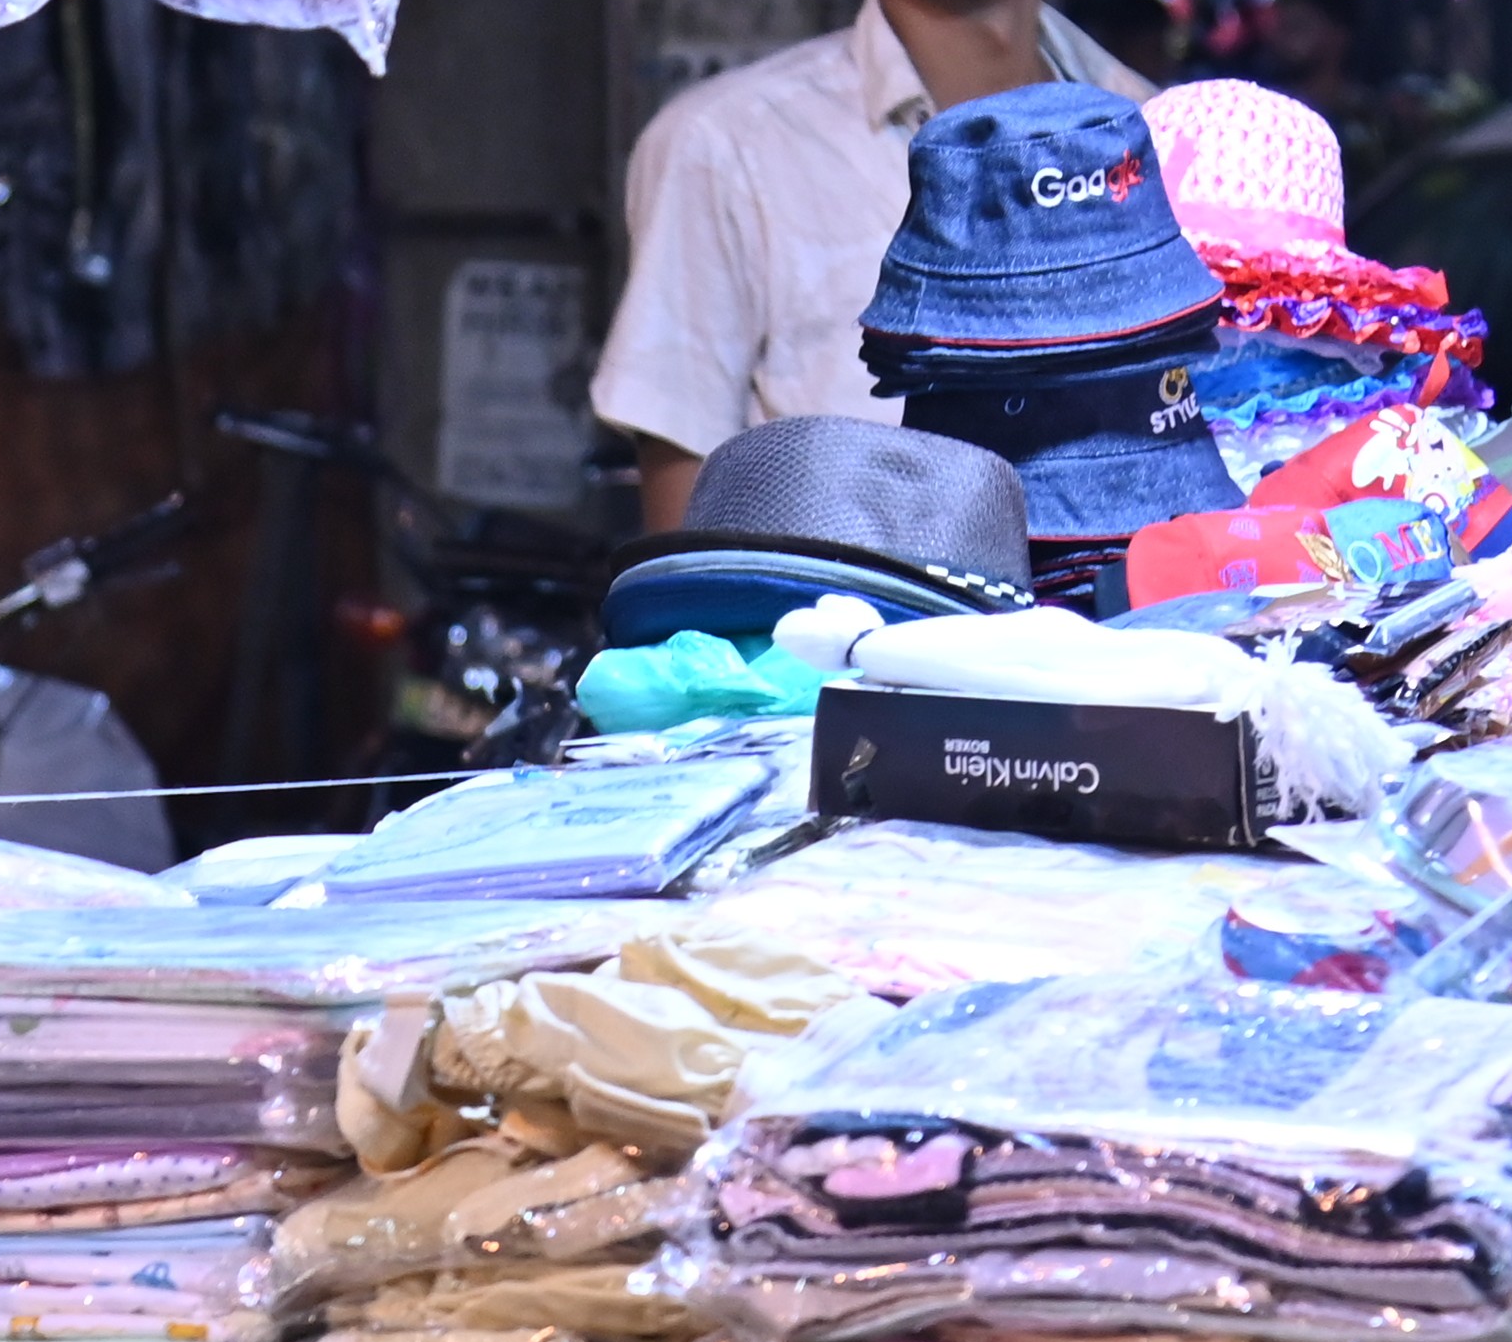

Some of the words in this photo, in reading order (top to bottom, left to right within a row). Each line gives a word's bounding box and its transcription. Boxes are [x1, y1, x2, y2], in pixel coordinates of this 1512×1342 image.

[1150, 391, 1201, 435] STYLE
[944, 738, 991, 754] BOXER
[944, 754, 1011, 788] Klein
[1014, 759, 1101, 794] Calvin
